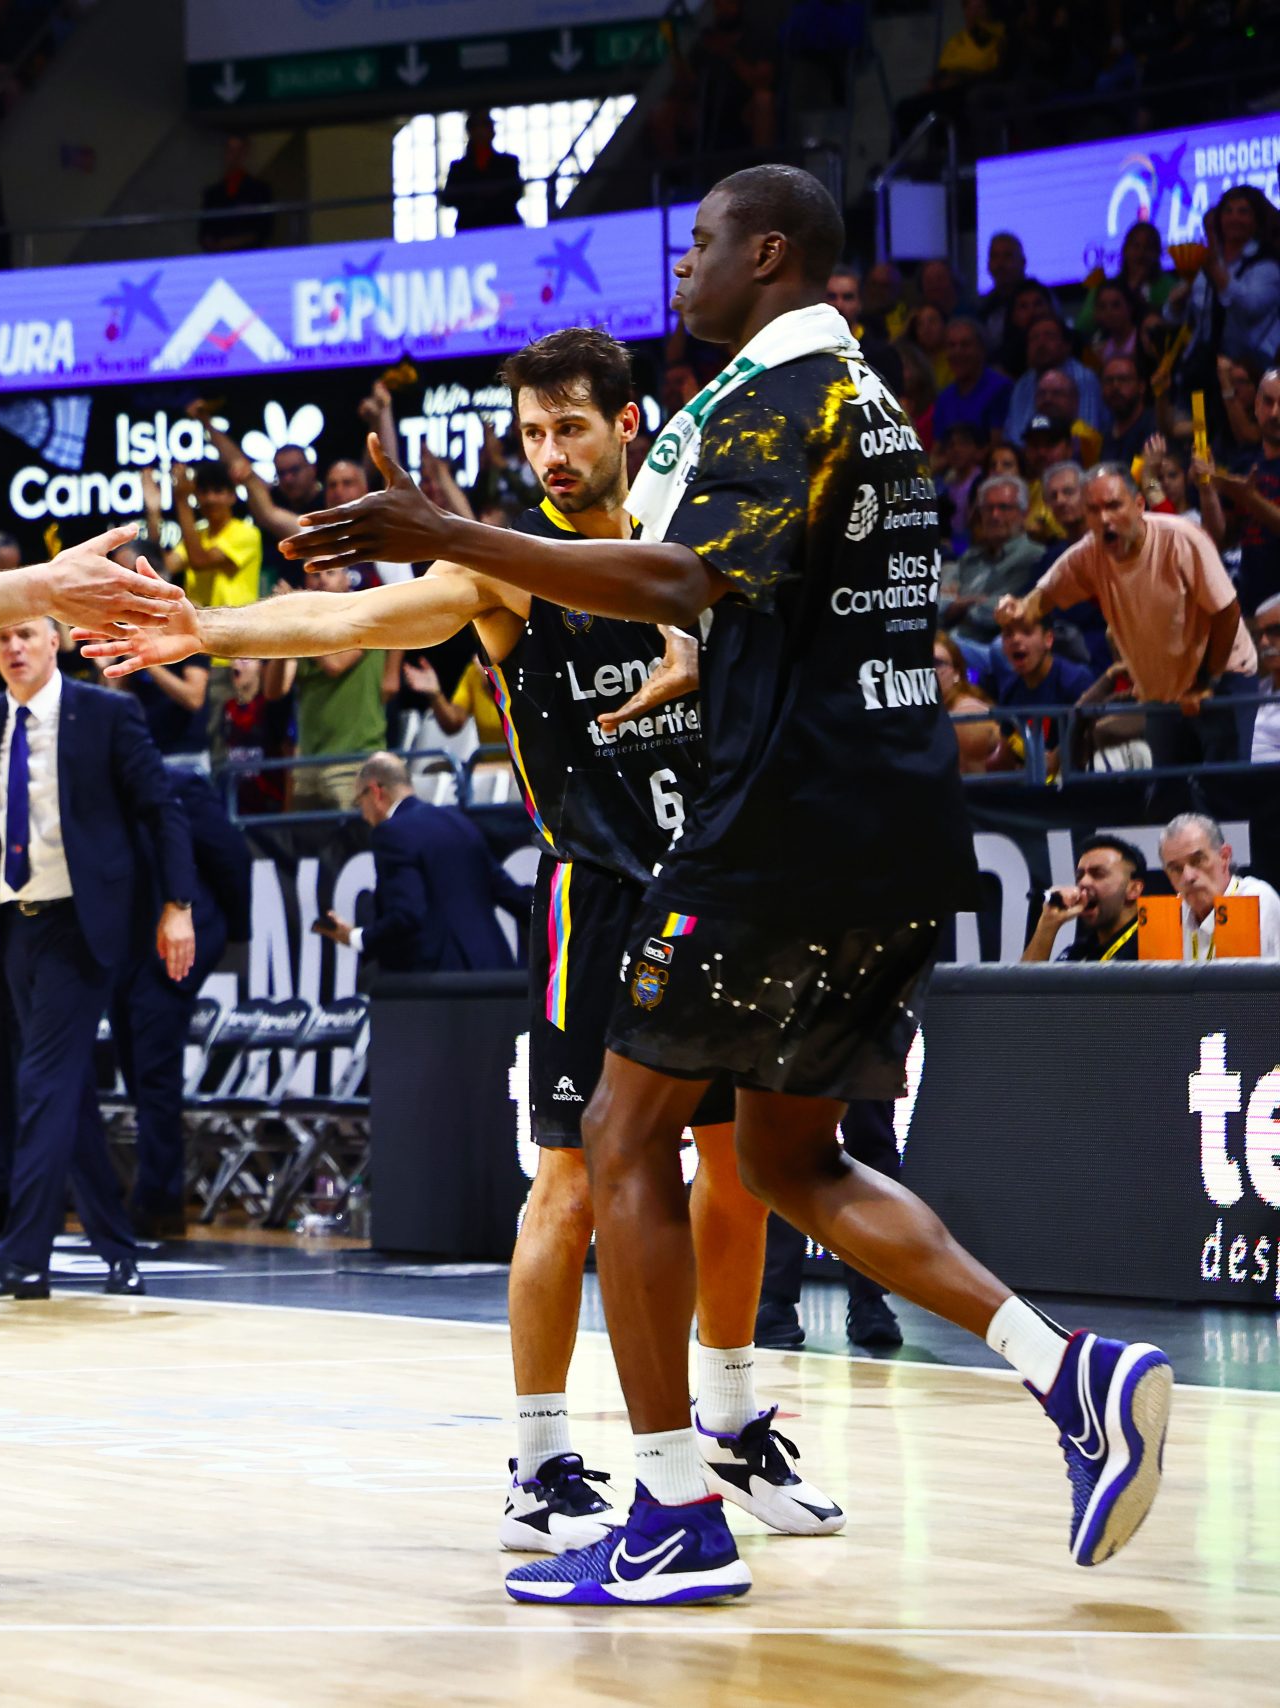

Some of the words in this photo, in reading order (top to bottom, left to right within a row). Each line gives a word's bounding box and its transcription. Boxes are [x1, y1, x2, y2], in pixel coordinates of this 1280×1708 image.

[292, 263, 500, 347] ESPUMAS
[649, 768, 685, 830] 6
[1201, 1217, 1280, 1300] des
